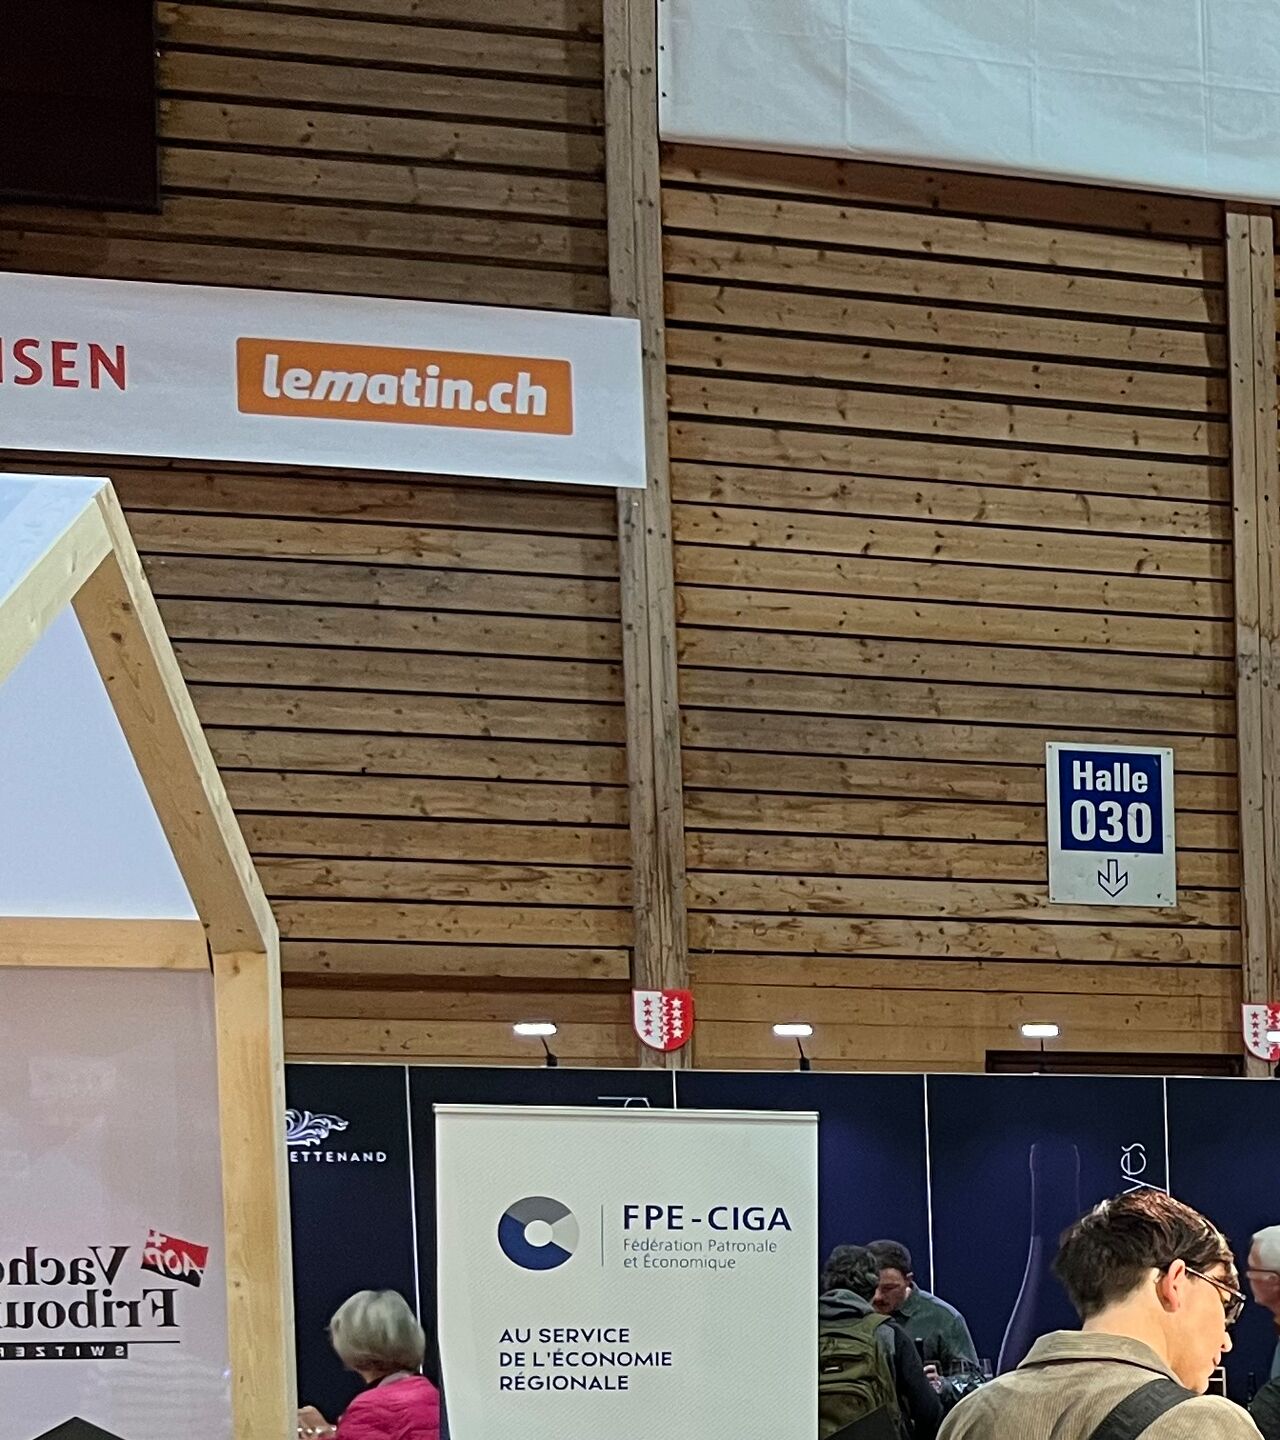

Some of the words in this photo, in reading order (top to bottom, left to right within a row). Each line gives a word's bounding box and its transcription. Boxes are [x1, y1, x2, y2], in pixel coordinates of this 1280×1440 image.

[262, 353, 548, 417] lematin.ch
[1072, 760, 1149, 793] Halle
[1070, 799, 1153, 844] 030
[623, 1238, 703, 1253] Fédération
[707, 1239, 778, 1254] Patronale
[623, 1257, 639, 1269] et
[644, 1253, 737, 1271] Économique
[499, 1327, 532, 1344] AU
[538, 1327, 631, 1344] SERVICE
[499, 1351, 526, 1368] DE
[533, 1348, 673, 1368] L'ÉCONOMIE
[499, 1371, 630, 1391] RÉGIONALE
